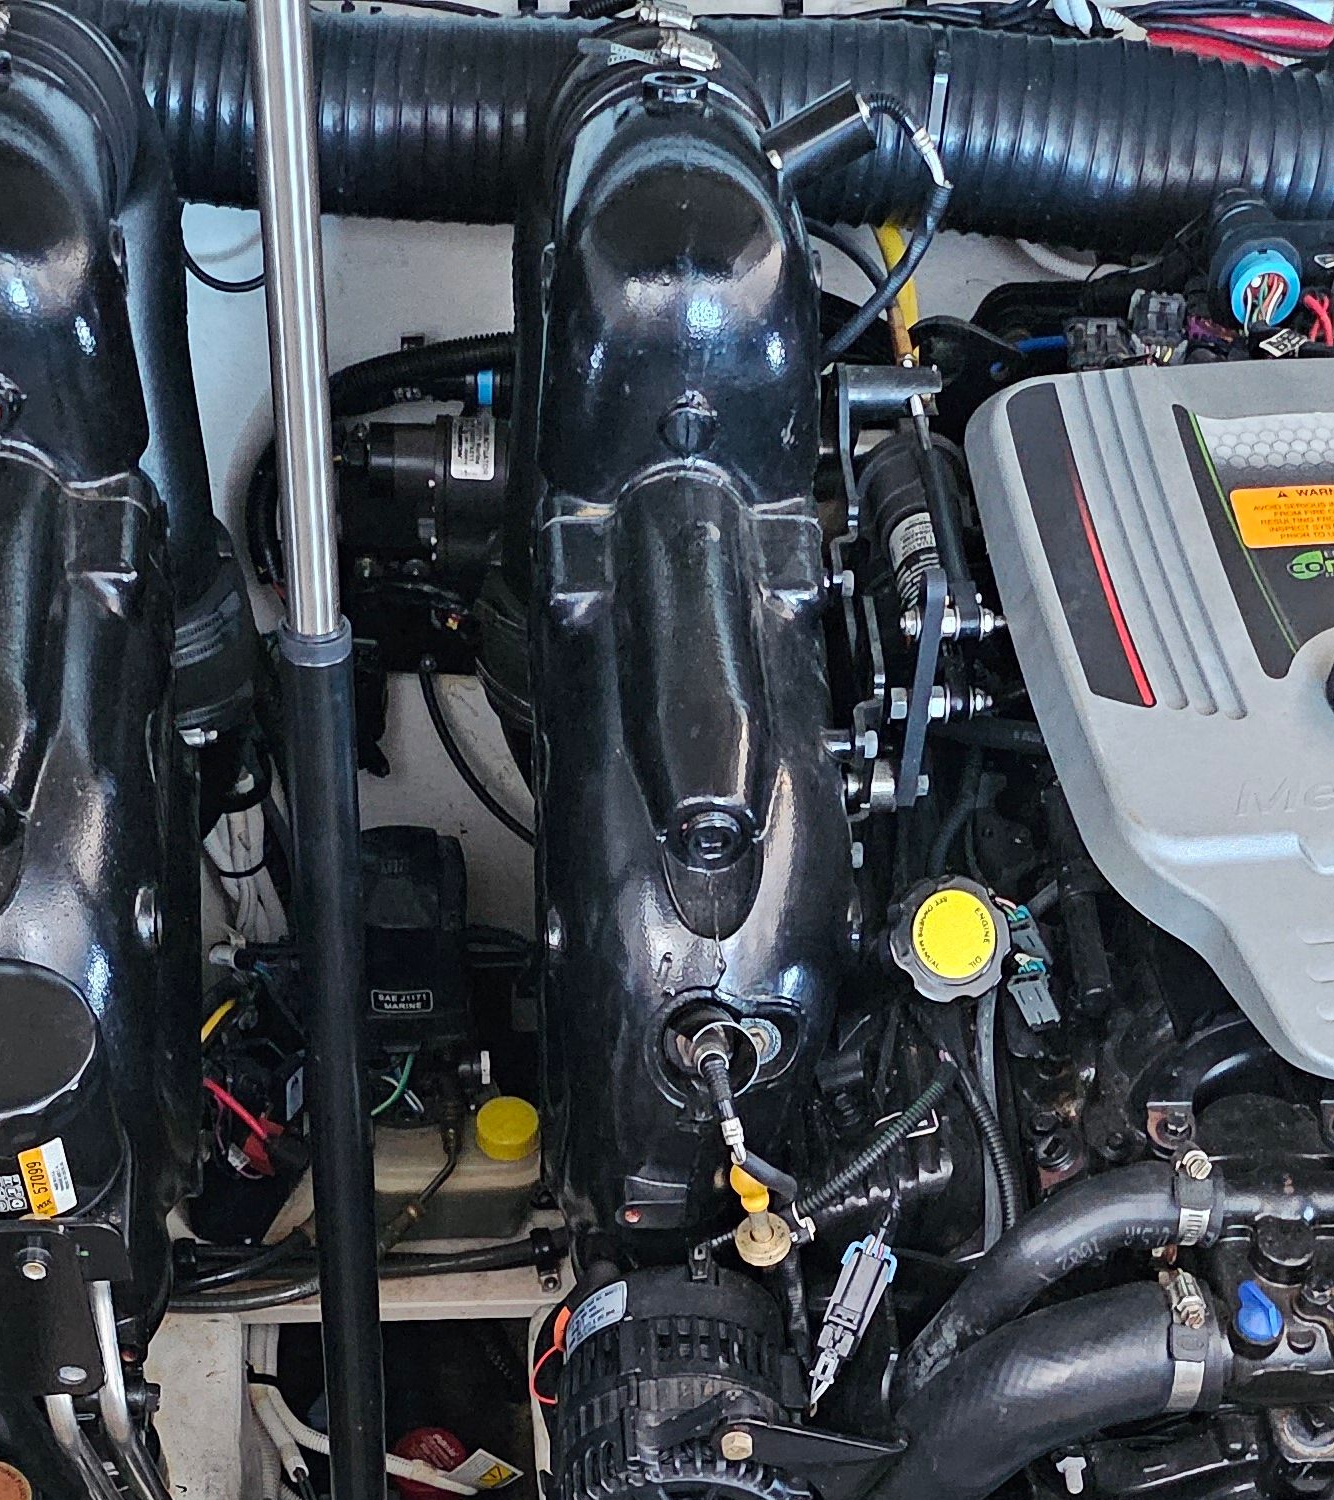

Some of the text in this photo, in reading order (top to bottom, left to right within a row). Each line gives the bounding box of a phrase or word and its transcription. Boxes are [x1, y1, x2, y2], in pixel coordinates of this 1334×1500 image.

[1280, 531, 1310, 539] PRIOR
[934, 896, 948, 906] SEE
[968, 907, 991, 968] ENGINE OIL
[919, 940, 940, 971] MANUAL
[378, 993, 427, 1002] SAE J1171
[383, 1001, 422, 1010] MARINE
[25, 1160, 49, 1196] 57099
